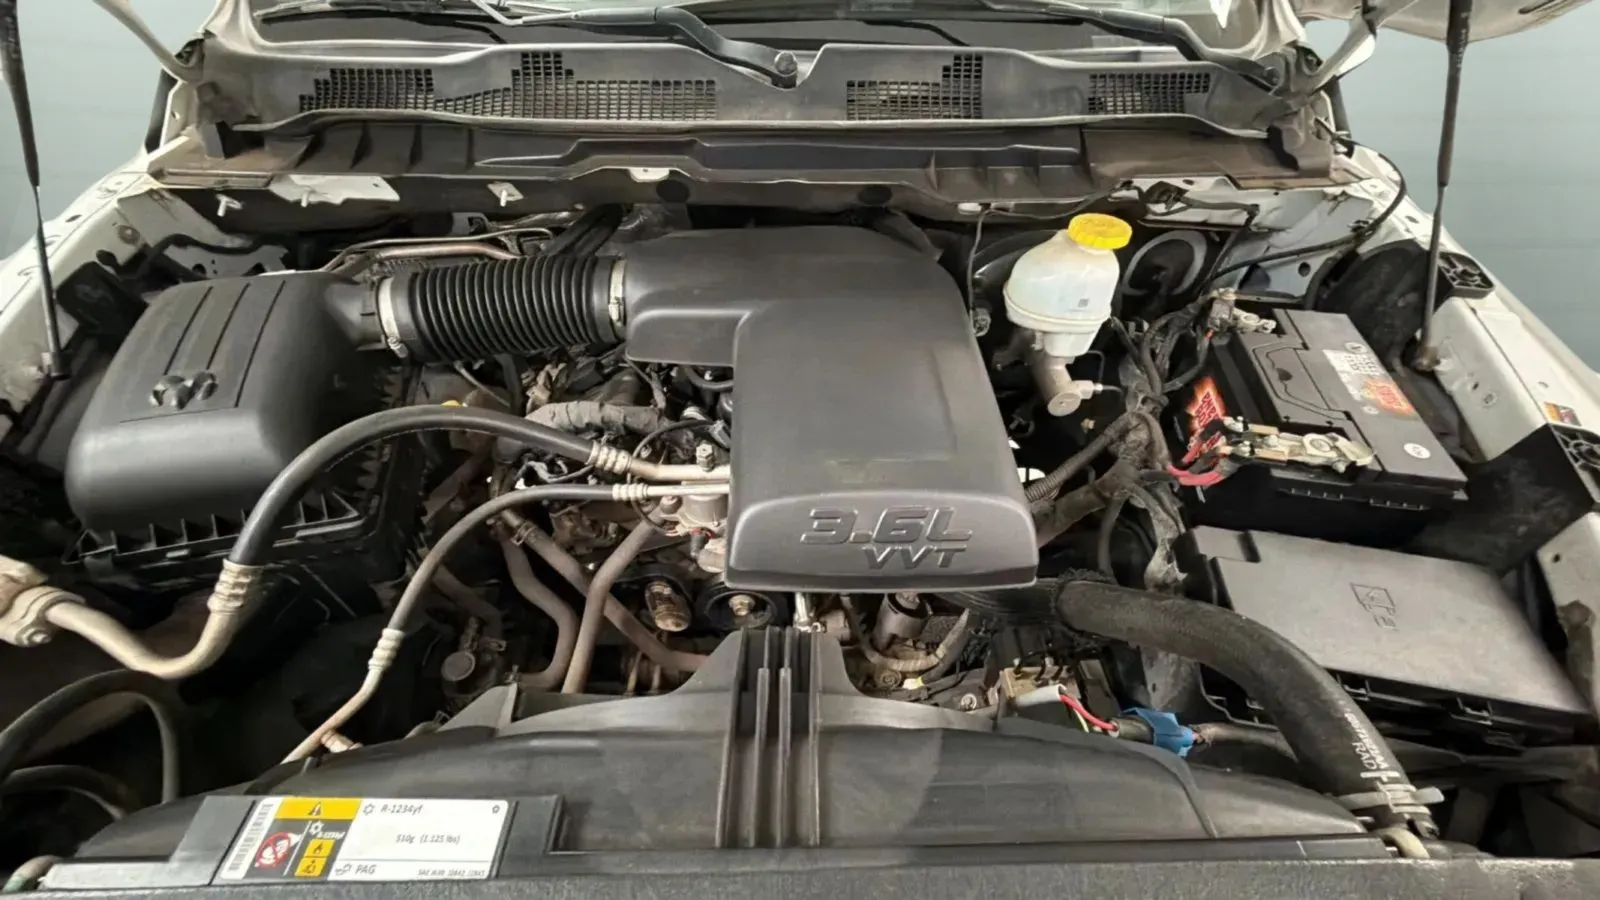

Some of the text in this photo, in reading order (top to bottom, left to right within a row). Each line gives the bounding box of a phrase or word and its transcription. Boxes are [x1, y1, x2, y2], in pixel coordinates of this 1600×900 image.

[800, 505, 973, 545] 3.6L
[862, 544, 968, 570] VVT
[380, 803, 423, 816] R-1234yf
[355, 864, 377, 875] PAG
